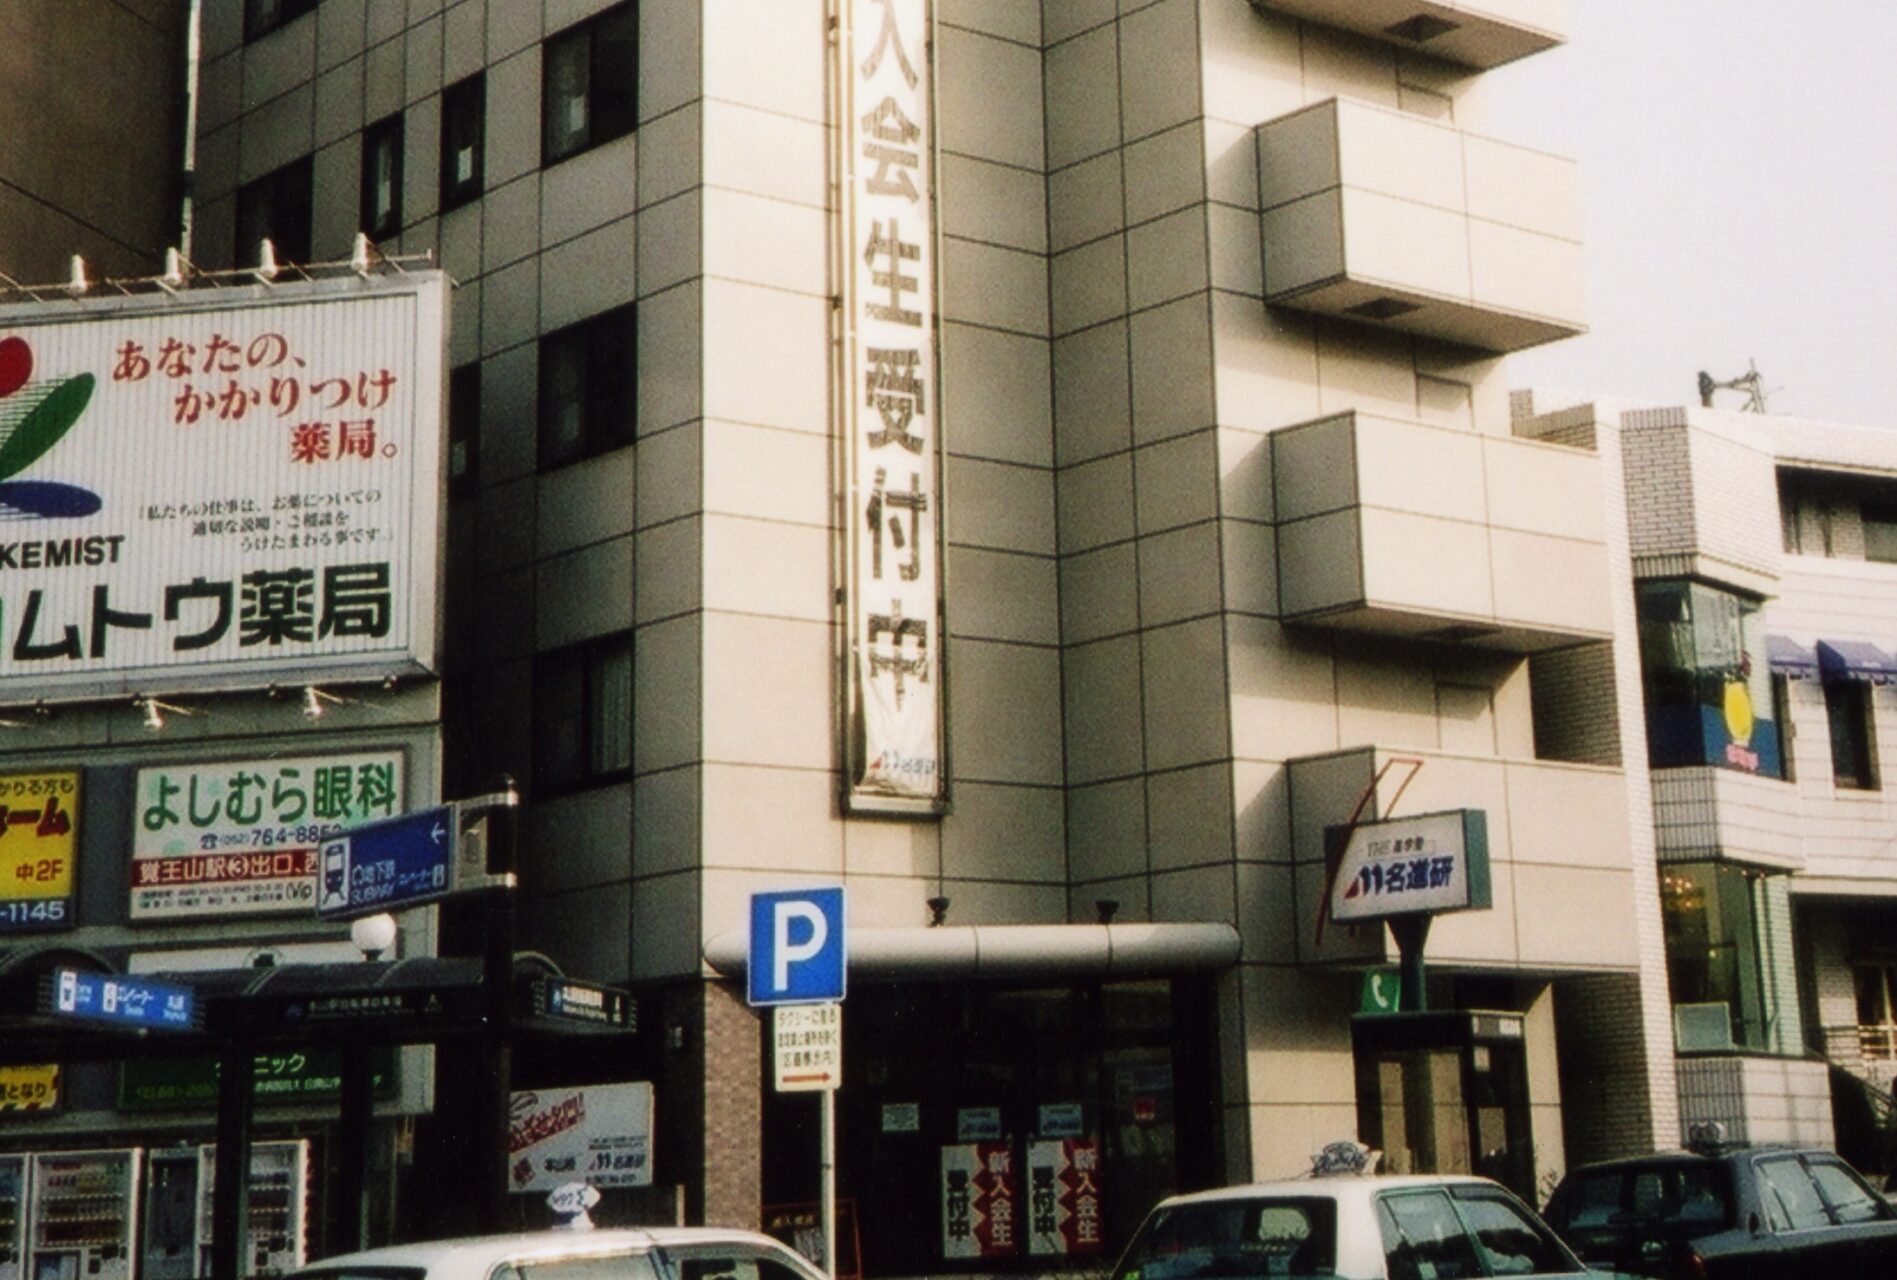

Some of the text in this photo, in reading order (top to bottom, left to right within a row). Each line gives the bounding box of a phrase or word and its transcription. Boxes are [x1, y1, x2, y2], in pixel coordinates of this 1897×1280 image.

[112, 332, 306, 383] あなたの、
[174, 368, 398, 425] かかりつけ
[291, 418, 398, 464] 薬局。
[0, 534, 125, 570] KEMIST
[0, 794, 71, 837] ーム
[143, 761, 397, 831] よしむら眼科
[1386, 856, 1454, 893] 名進研
[773, 900, 828, 992] P
[947, 1169, 970, 1241] 受付中
[988, 1151, 1013, 1246] 新入会生
[1032, 1166, 1056, 1237] 受付中
[1073, 1148, 1099, 1243] 新入会生
